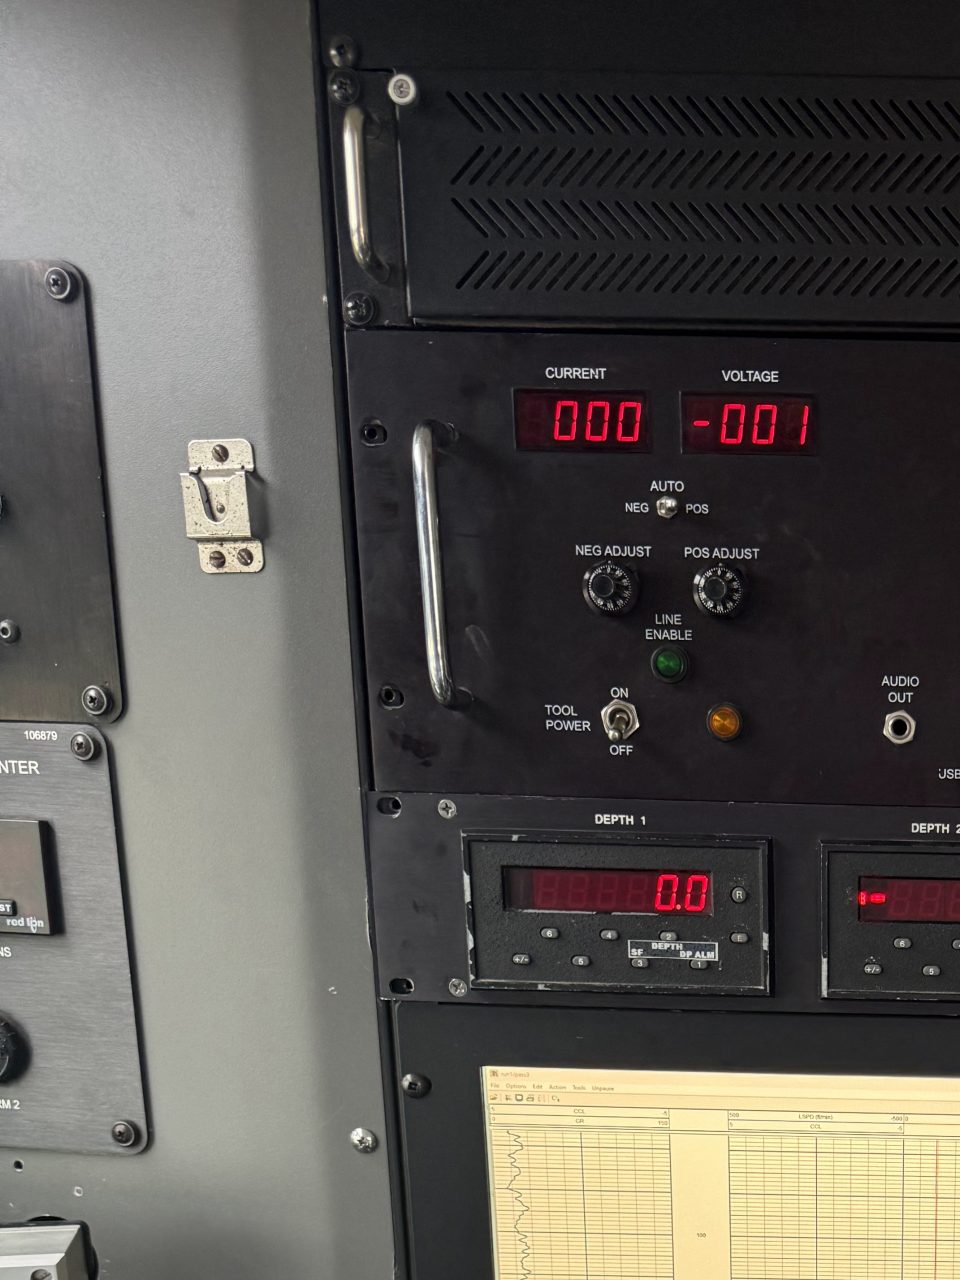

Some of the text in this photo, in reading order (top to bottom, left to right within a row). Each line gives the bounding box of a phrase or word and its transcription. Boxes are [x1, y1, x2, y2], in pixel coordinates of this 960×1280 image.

[545, 367, 607, 380] CURRENT
[722, 370, 779, 383] VOLTAGE
[553, 400, 642, 442] 000
[650, 480, 684, 493] AUTO
[625, 502, 649, 514] NEG
[685, 503, 709, 515] POS
[575, 545, 652, 558] NEG ADJUST
[684, 547, 760, 560] POS ADJUST
[655, 614, 682, 625] LINE
[645, 629, 693, 641] ENABLE
[881, 676, 920, 687] AUDIO
[610, 687, 629, 699] ON
[888, 692, 913, 703] OUT
[544, 704, 578, 717] TOOL
[545, 720, 591, 732] POWER
[23, 730, 58, 741] 106879
[609, 745, 633, 756] OFF
[594, 813, 647, 826] DEPTH 1
[911, 823, 950, 834] DEPTH
[655, 874, 709, 912] 0.0
[6, 917, 25, 927] red
[651, 942, 683, 951] DEPTH
[630, 948, 715, 959] SF DP ALM
